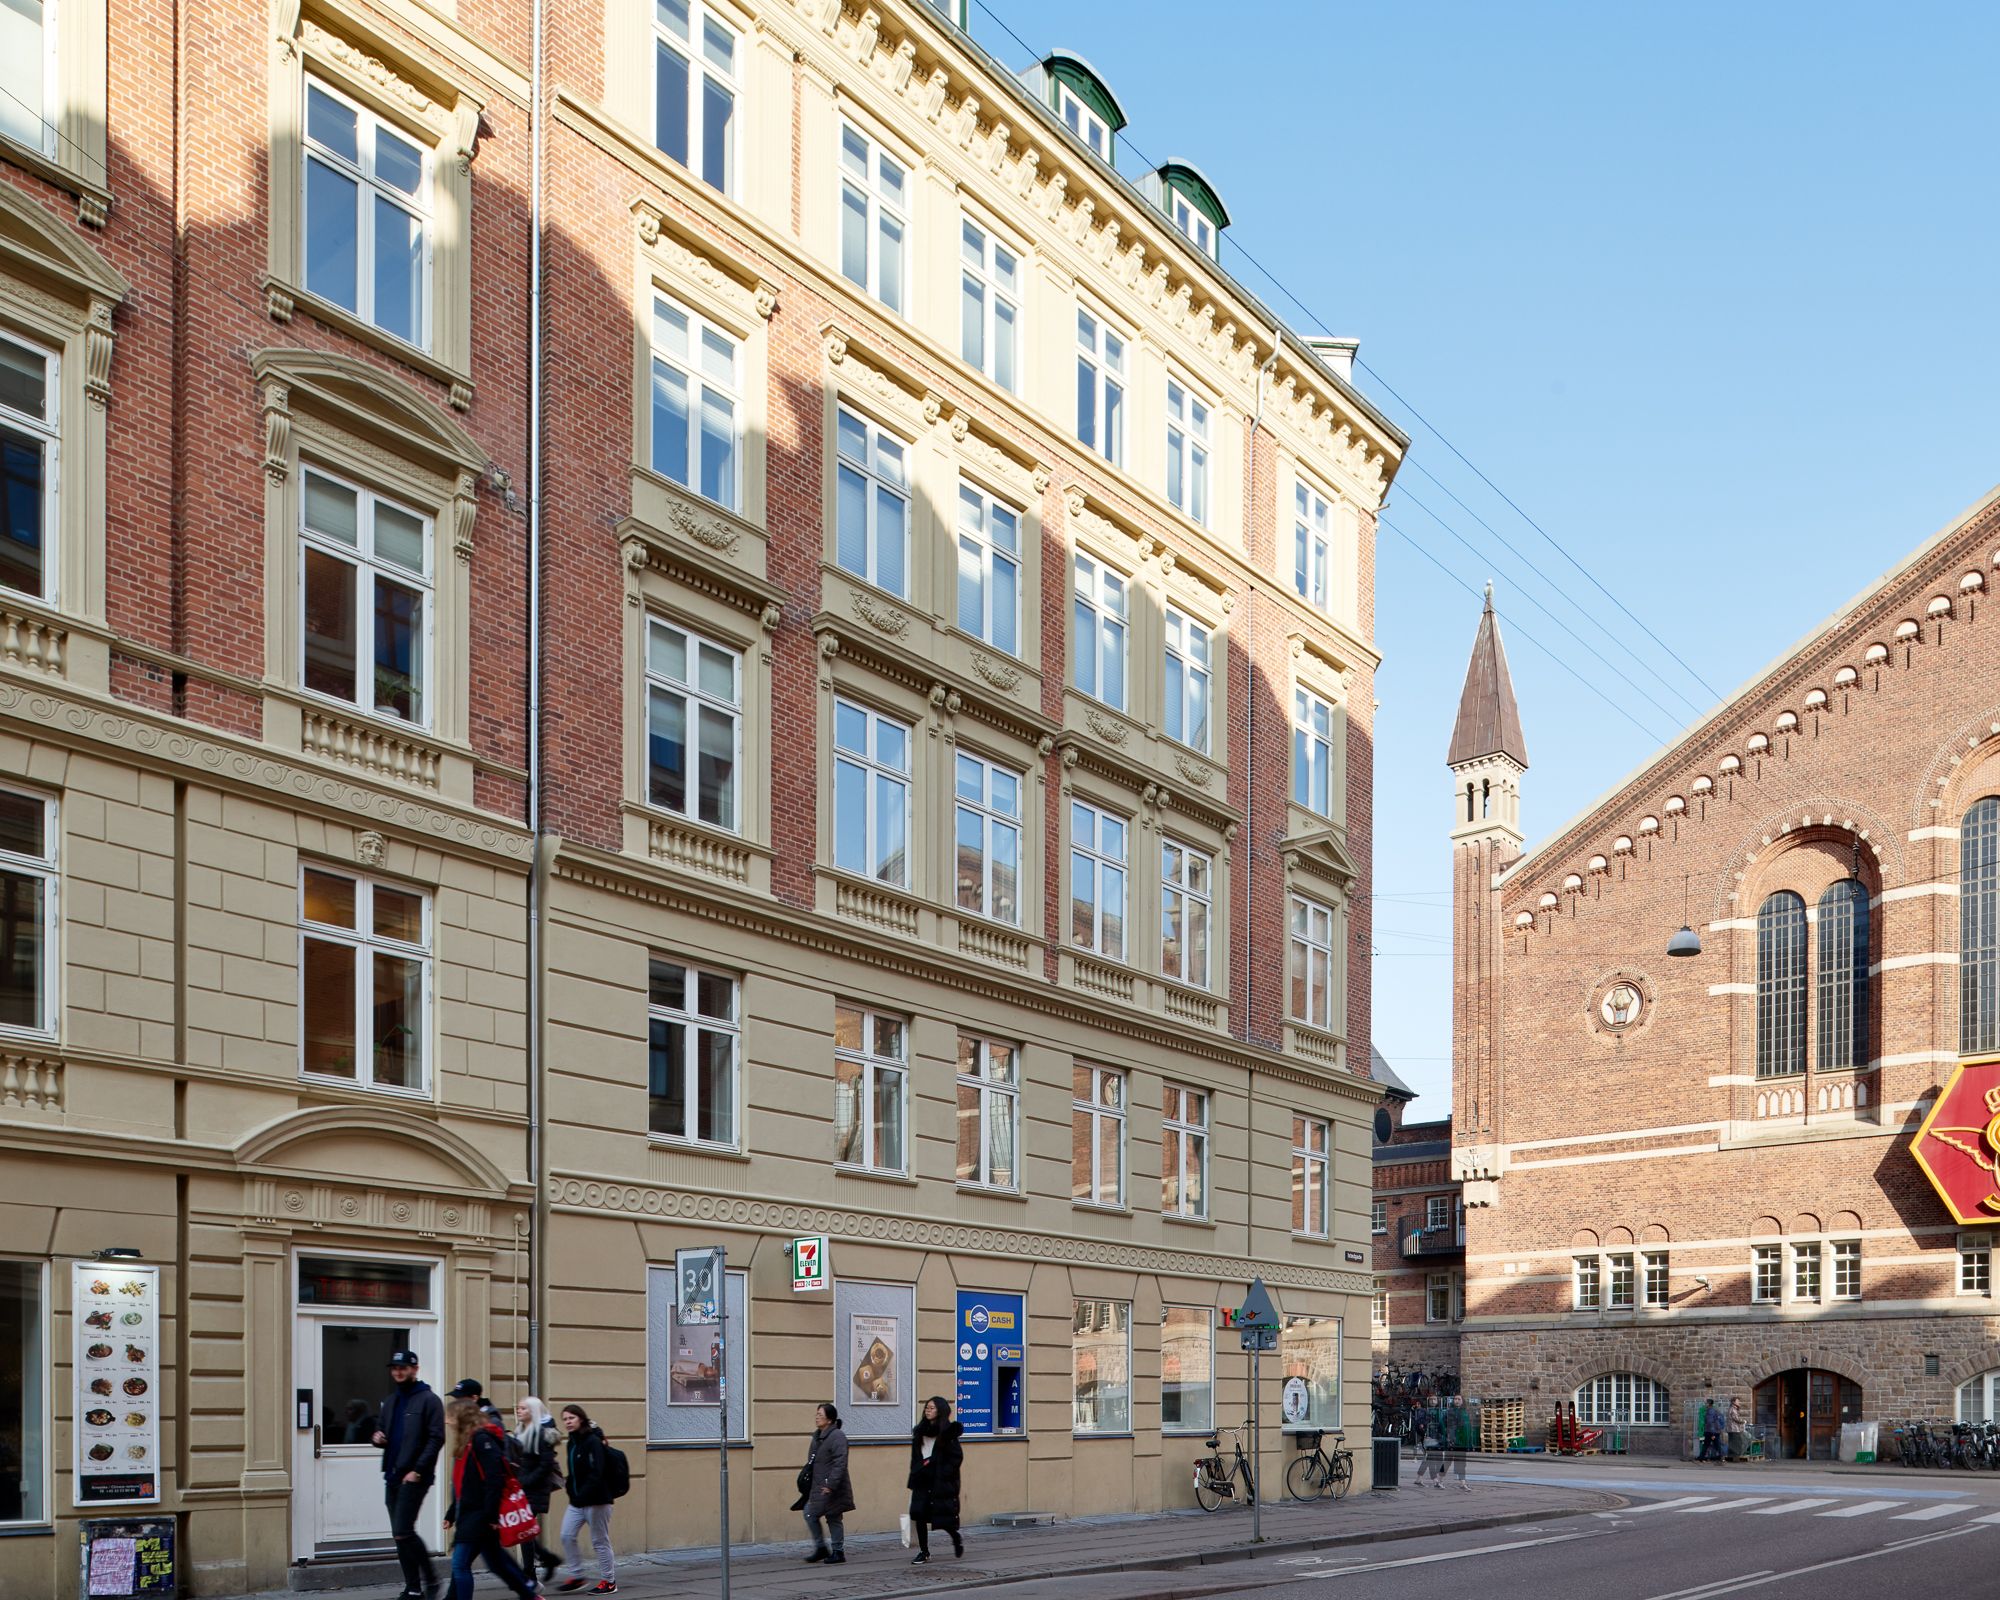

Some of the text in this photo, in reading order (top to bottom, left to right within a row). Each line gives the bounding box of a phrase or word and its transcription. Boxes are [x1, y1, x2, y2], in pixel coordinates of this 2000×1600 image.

[800, 1245, 816, 1276] 7
[685, 1269, 712, 1292] 30
[991, 1316, 1012, 1324] CASH
